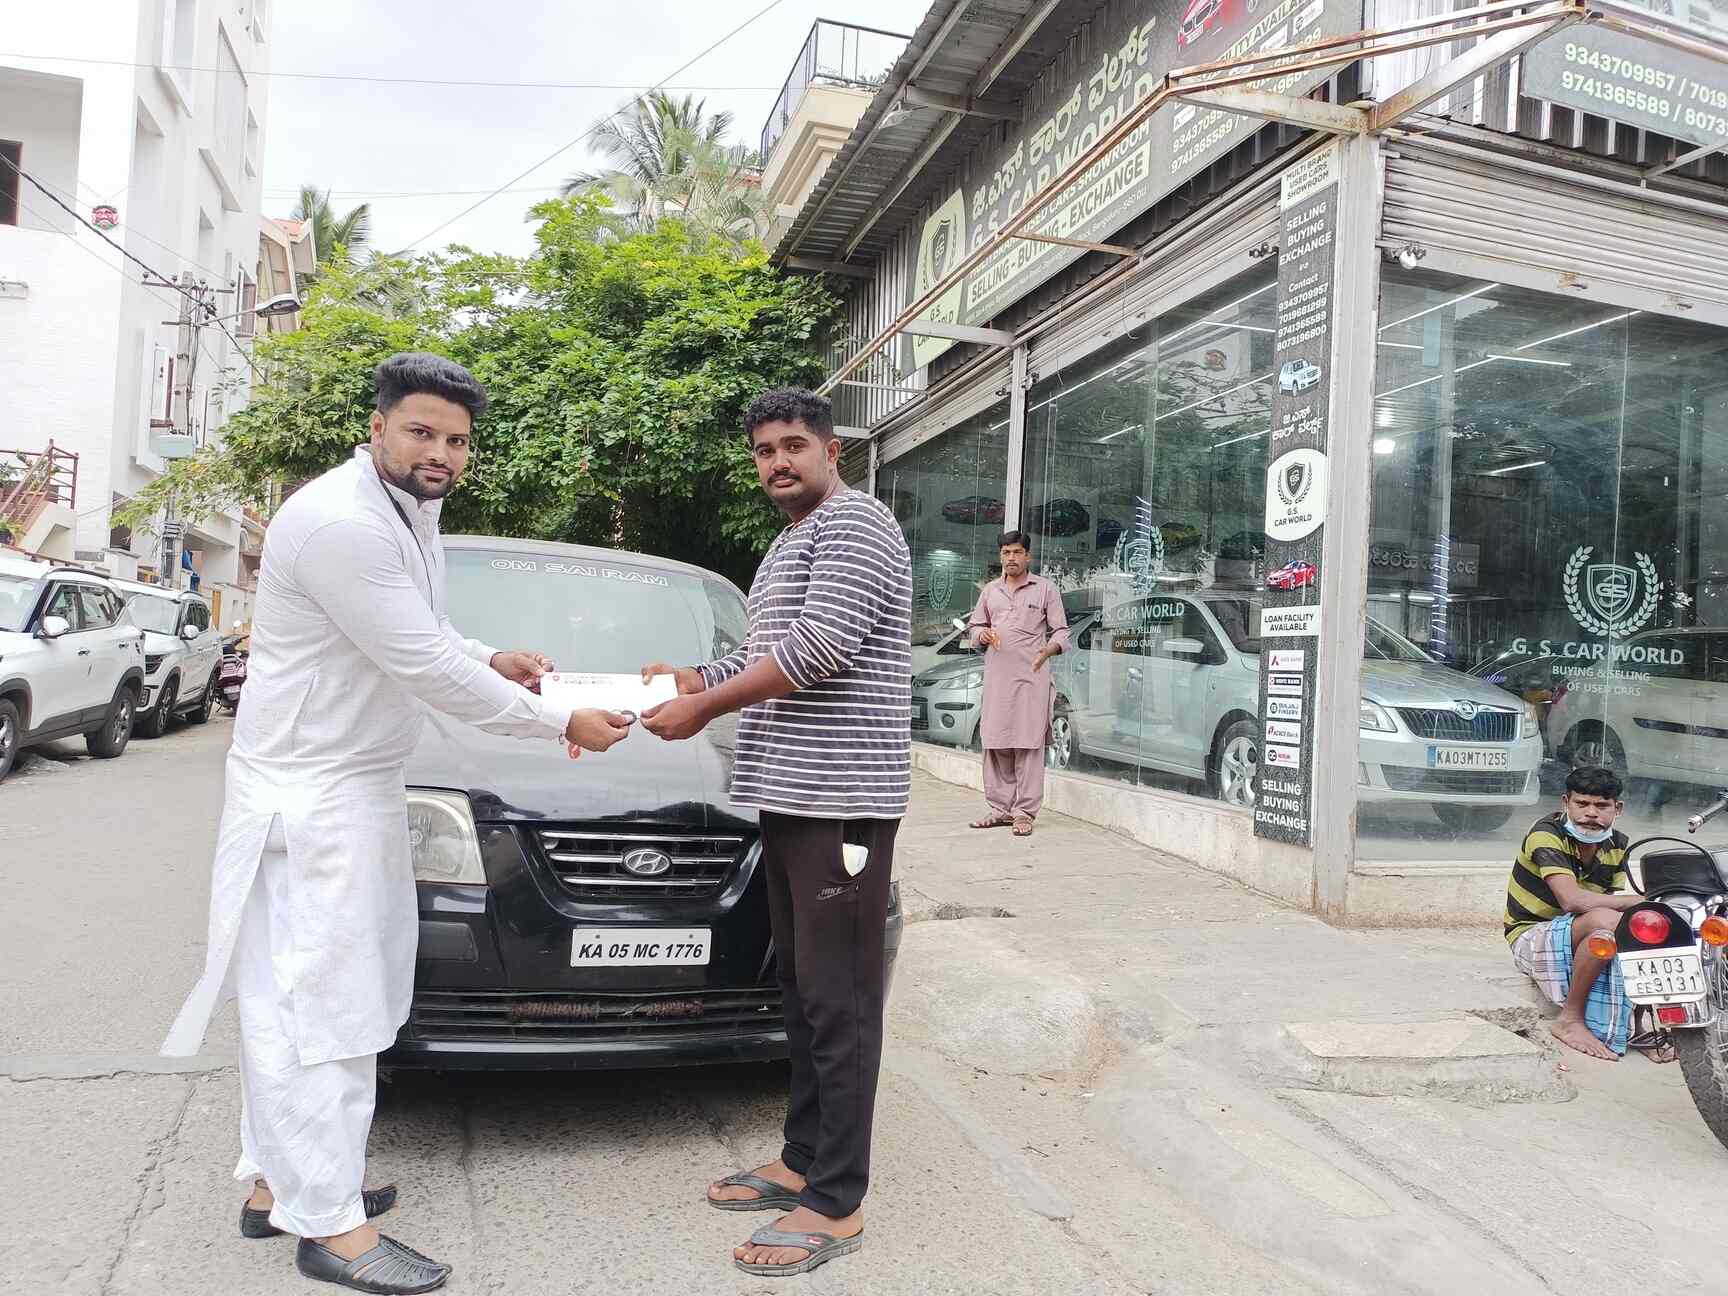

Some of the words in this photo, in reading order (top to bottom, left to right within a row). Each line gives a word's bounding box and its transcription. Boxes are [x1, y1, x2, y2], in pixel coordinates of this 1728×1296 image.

[1564, 42, 1676, 91] 9343709957
[1561, 71, 1670, 117] 9741365589
[1286, 201, 1327, 232] SELLING
[971, 258, 1010, 303] SELLING
[1071, 150, 1144, 227] EXCHANGE
[1287, 219, 1325, 247] BUYING
[1280, 231, 1332, 266] EXCHANGE
[1288, 273, 1319, 292] Contact
[1274, 518, 1287, 527] CAR
[1288, 513, 1312, 524] WORLD
[490, 559, 537, 572] OM
[544, 563, 597, 577] SAI
[601, 568, 669, 586] RAM
[1116, 606, 1138, 620] CAR
[1140, 602, 1185, 619] WORLD
[1264, 615, 1283, 623] LOAN
[1284, 613, 1314, 622] FACILITY
[1269, 622, 1308, 632] AVAILABLE
[1563, 642, 1605, 661] CAR
[1610, 644, 1684, 665] WORLD
[1552, 665, 1594, 678] BUYING
[1607, 668, 1650, 682] SELLING
[1566, 681, 1581, 692] OF
[1262, 779, 1301, 795] SELLING
[1263, 795, 1300, 812] BUYING
[1256, 810, 1307, 831] EXCHANGE
[579, 943, 602, 959] KA
[608, 943, 630, 959] 05
[633, 943, 661, 959] MC
[664, 943, 704, 959] 1776
